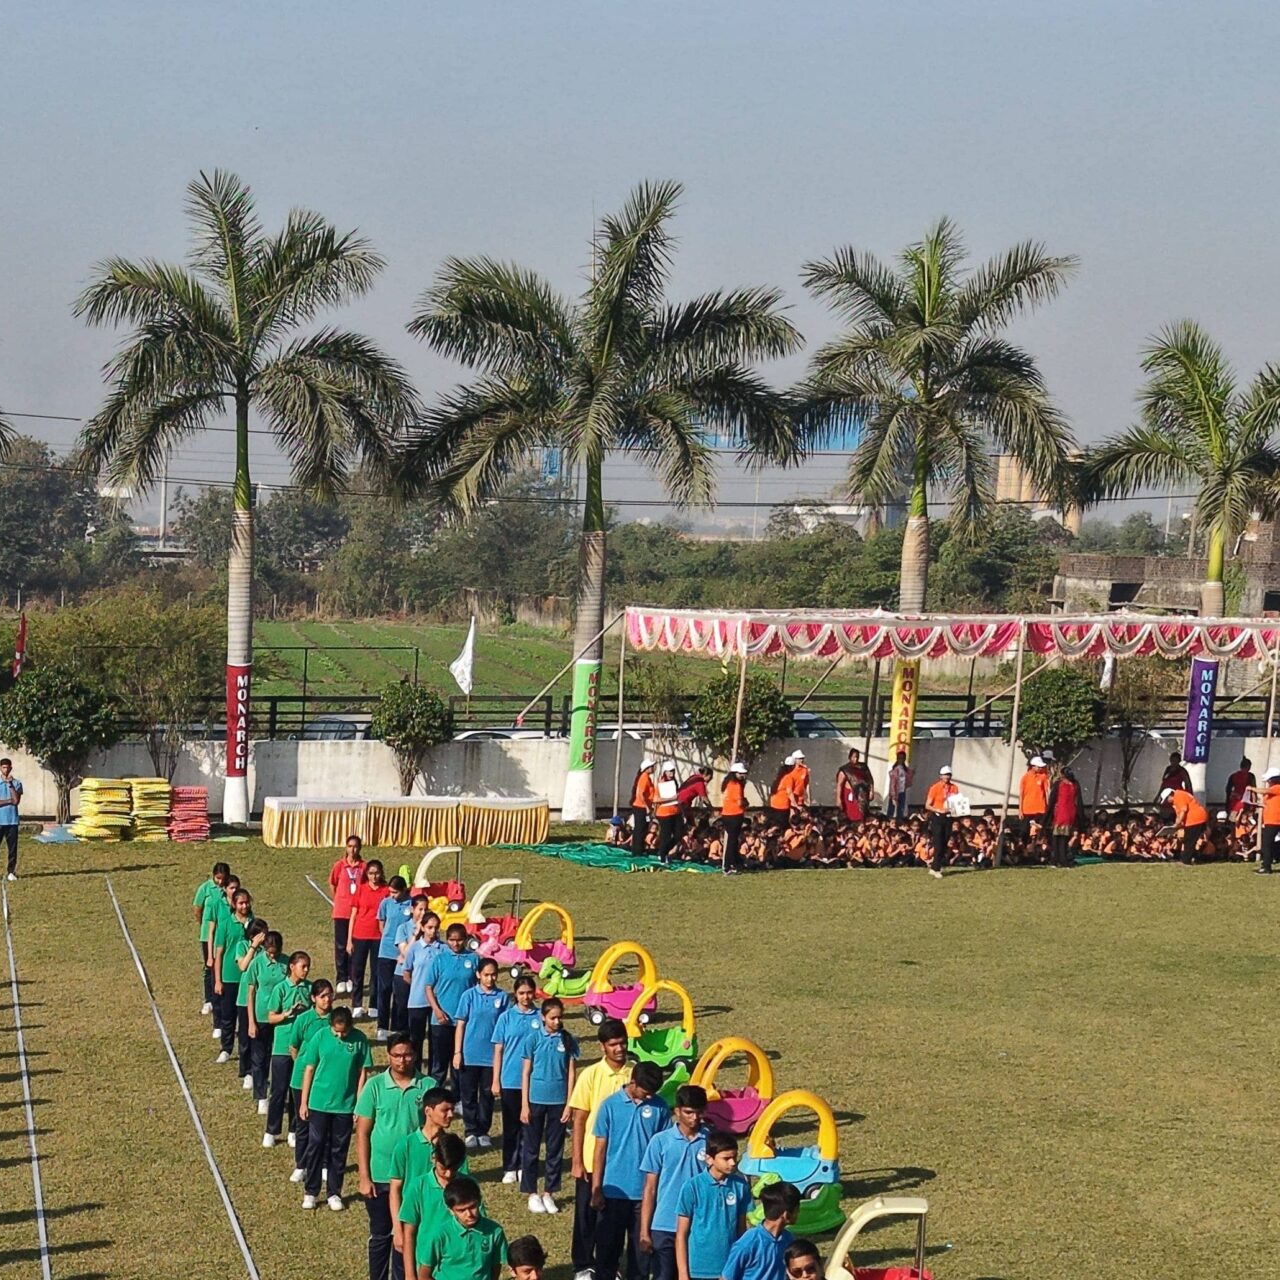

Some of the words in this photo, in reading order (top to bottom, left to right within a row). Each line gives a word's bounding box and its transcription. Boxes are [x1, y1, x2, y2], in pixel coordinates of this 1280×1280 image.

[235, 674, 249, 769] MONARCH
[582, 672, 599, 763] MONARCH
[1195, 669, 1213, 757] MONARCH
